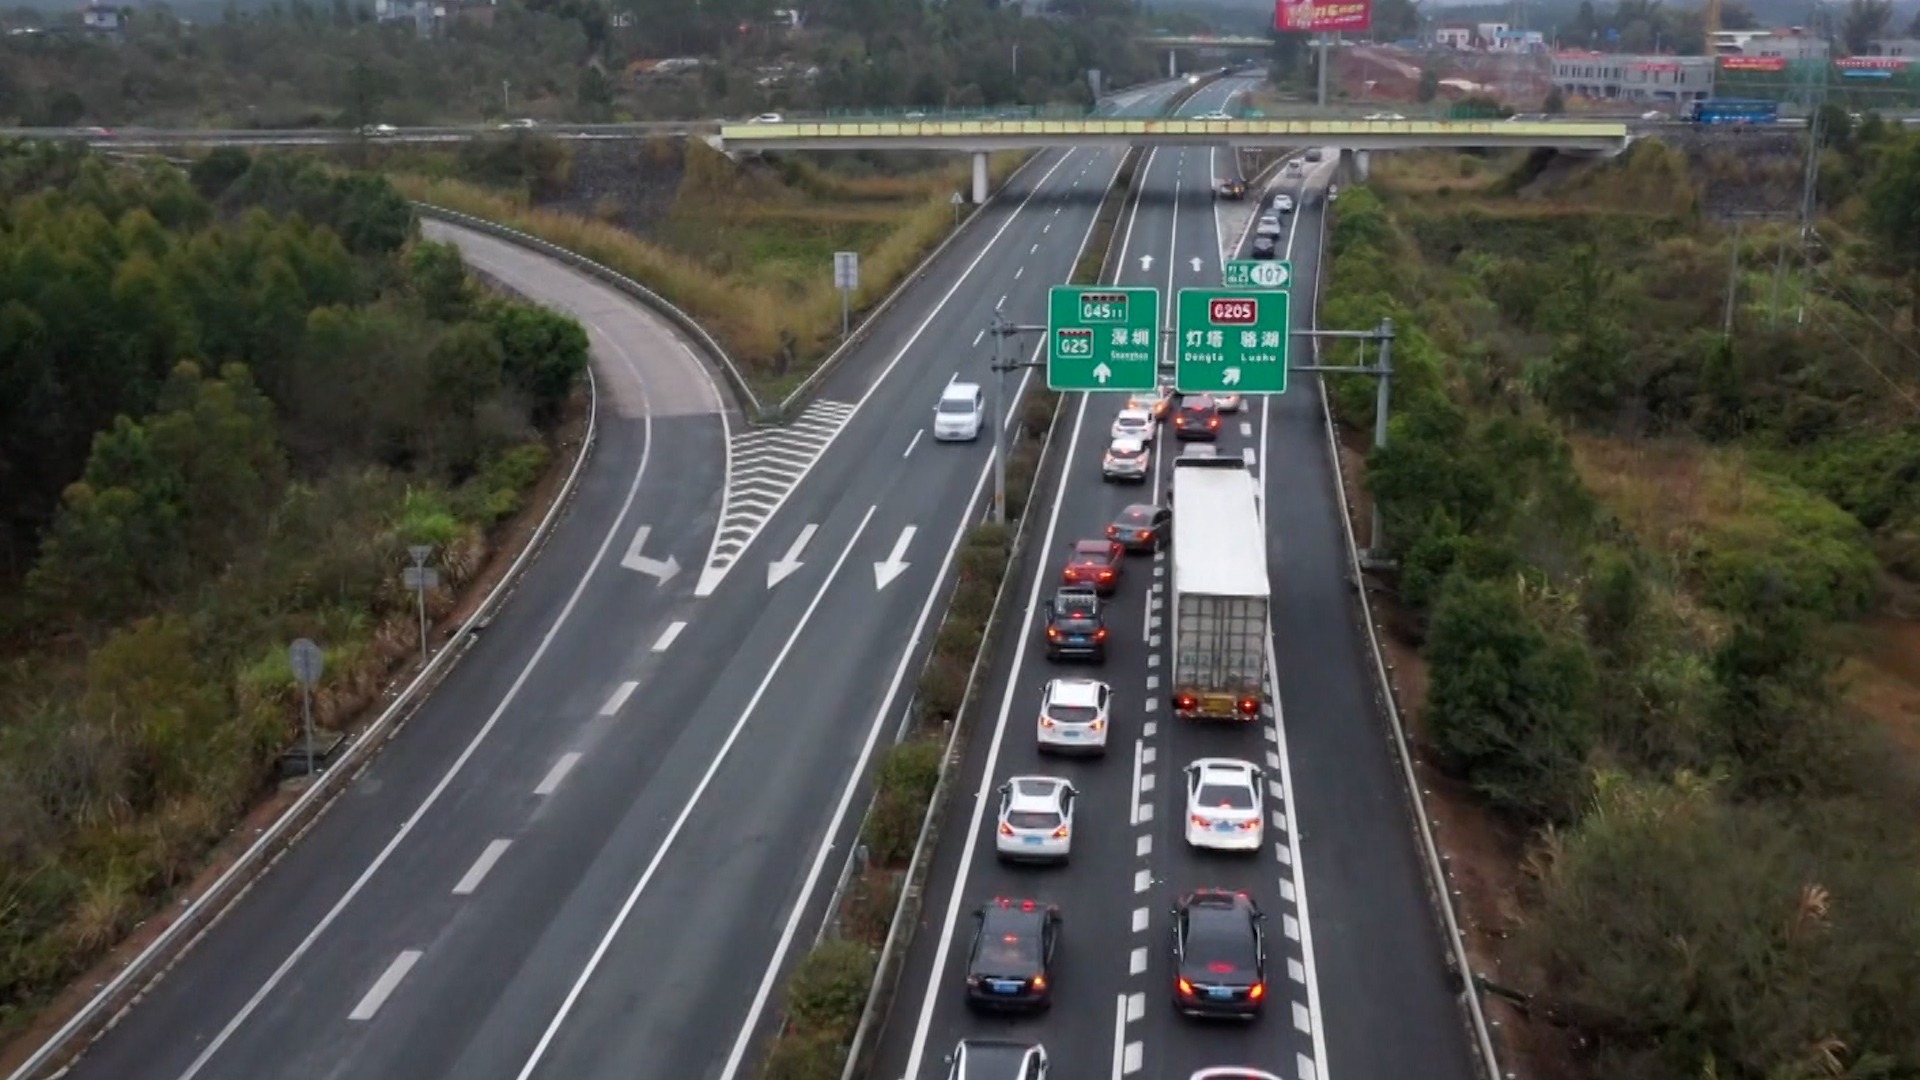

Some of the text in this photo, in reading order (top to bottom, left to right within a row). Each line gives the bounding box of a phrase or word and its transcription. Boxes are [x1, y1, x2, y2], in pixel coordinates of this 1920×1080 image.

[1258, 268, 1282, 283] 107
[1214, 303, 1252, 319] G205
[1111, 328, 1150, 347] 深圳
[1061, 339, 1089, 354] G25
